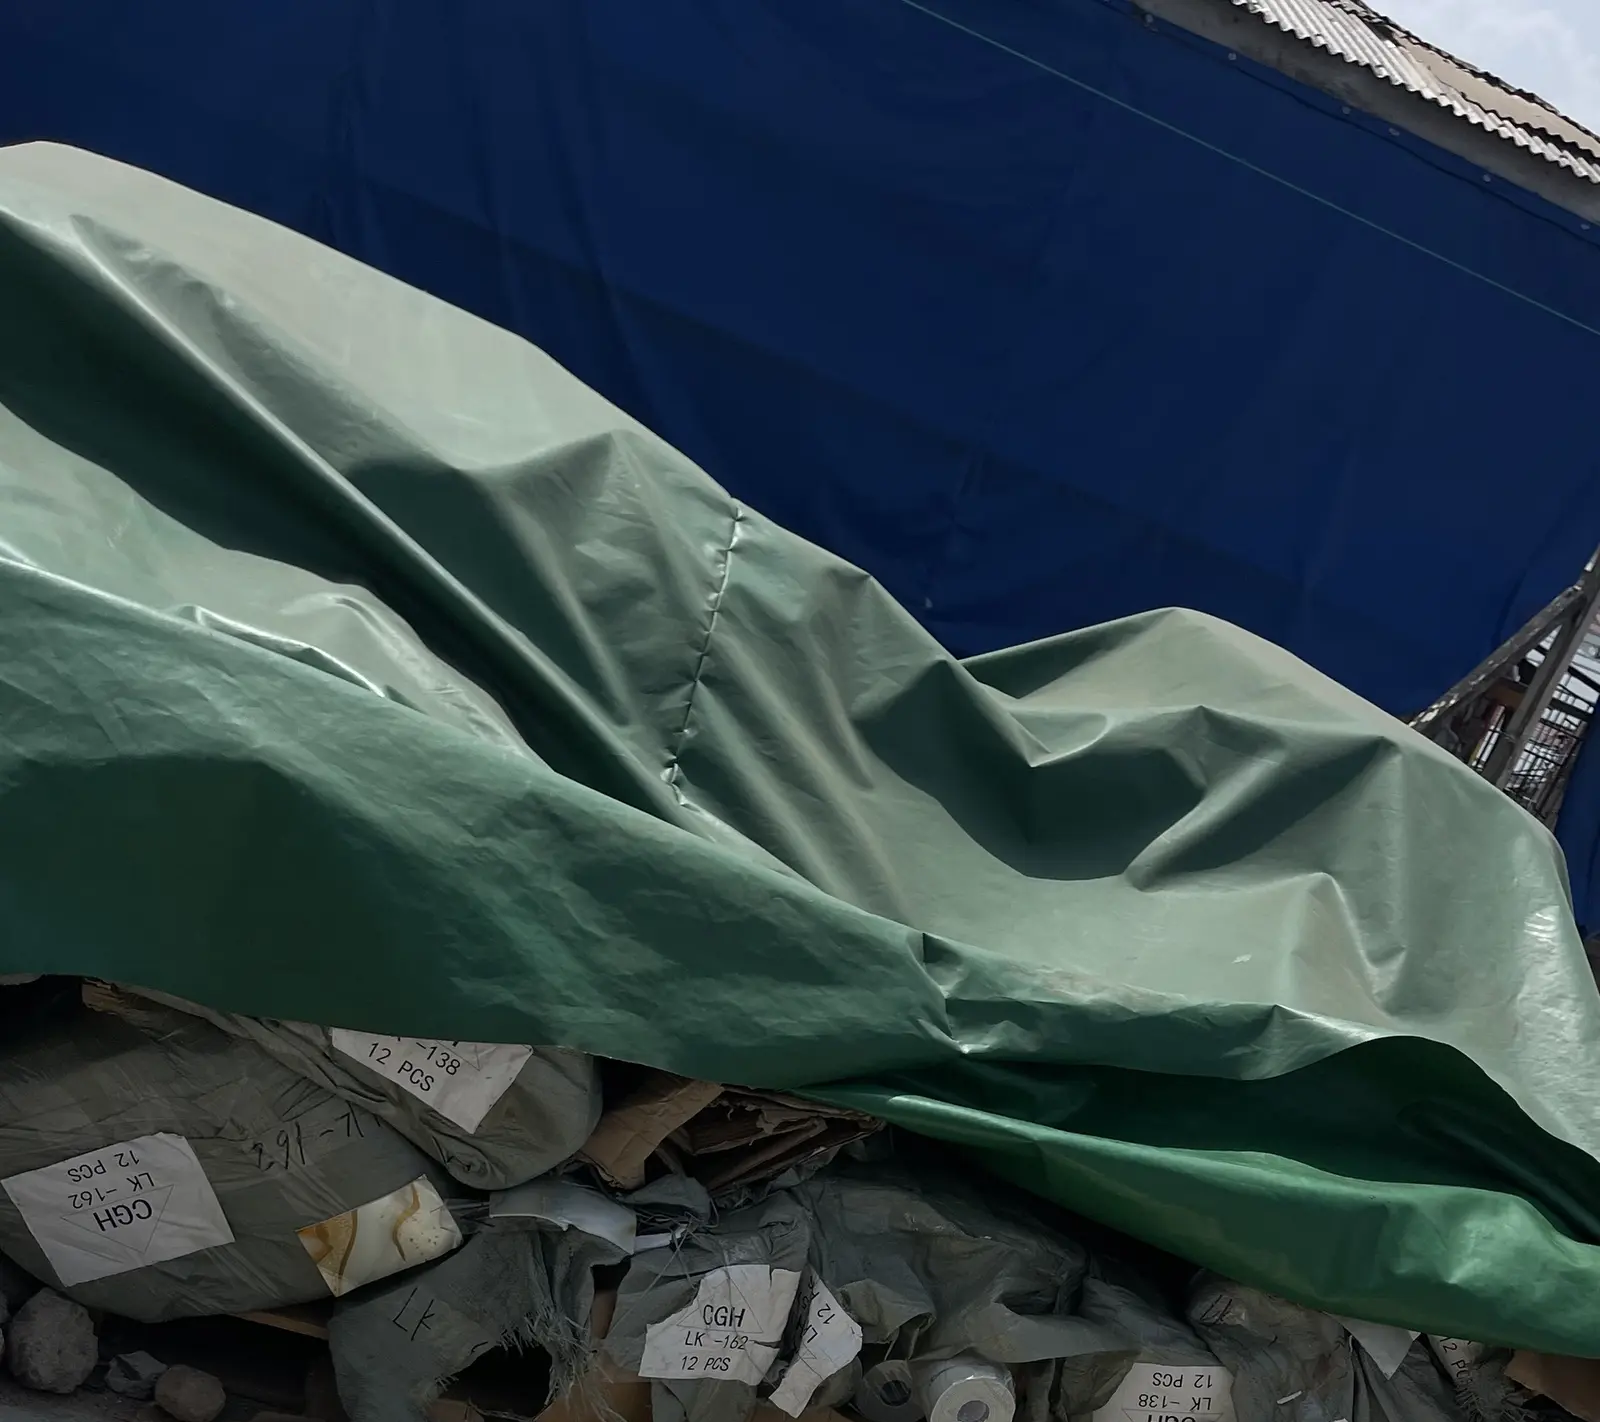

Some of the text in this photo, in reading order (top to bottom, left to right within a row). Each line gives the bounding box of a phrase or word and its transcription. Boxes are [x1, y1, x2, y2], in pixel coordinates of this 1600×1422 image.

[369, 1043, 435, 1092] 12 PCS
[416, 1042, 461, 1076] -138
[67, 1150, 140, 1182] 12 PCS
[67, 1172, 155, 1209] LK -162
[93, 1198, 153, 1232] CGH
[702, 1304, 745, 1328] CGH
[817, 1303, 836, 1325] 12
[685, 1330, 749, 1350] LK -162
[680, 1355, 731, 1371] 12 PCS
[1152, 1372, 1214, 1389] 12 PCS
[1138, 1394, 1212, 1412] LK -138
